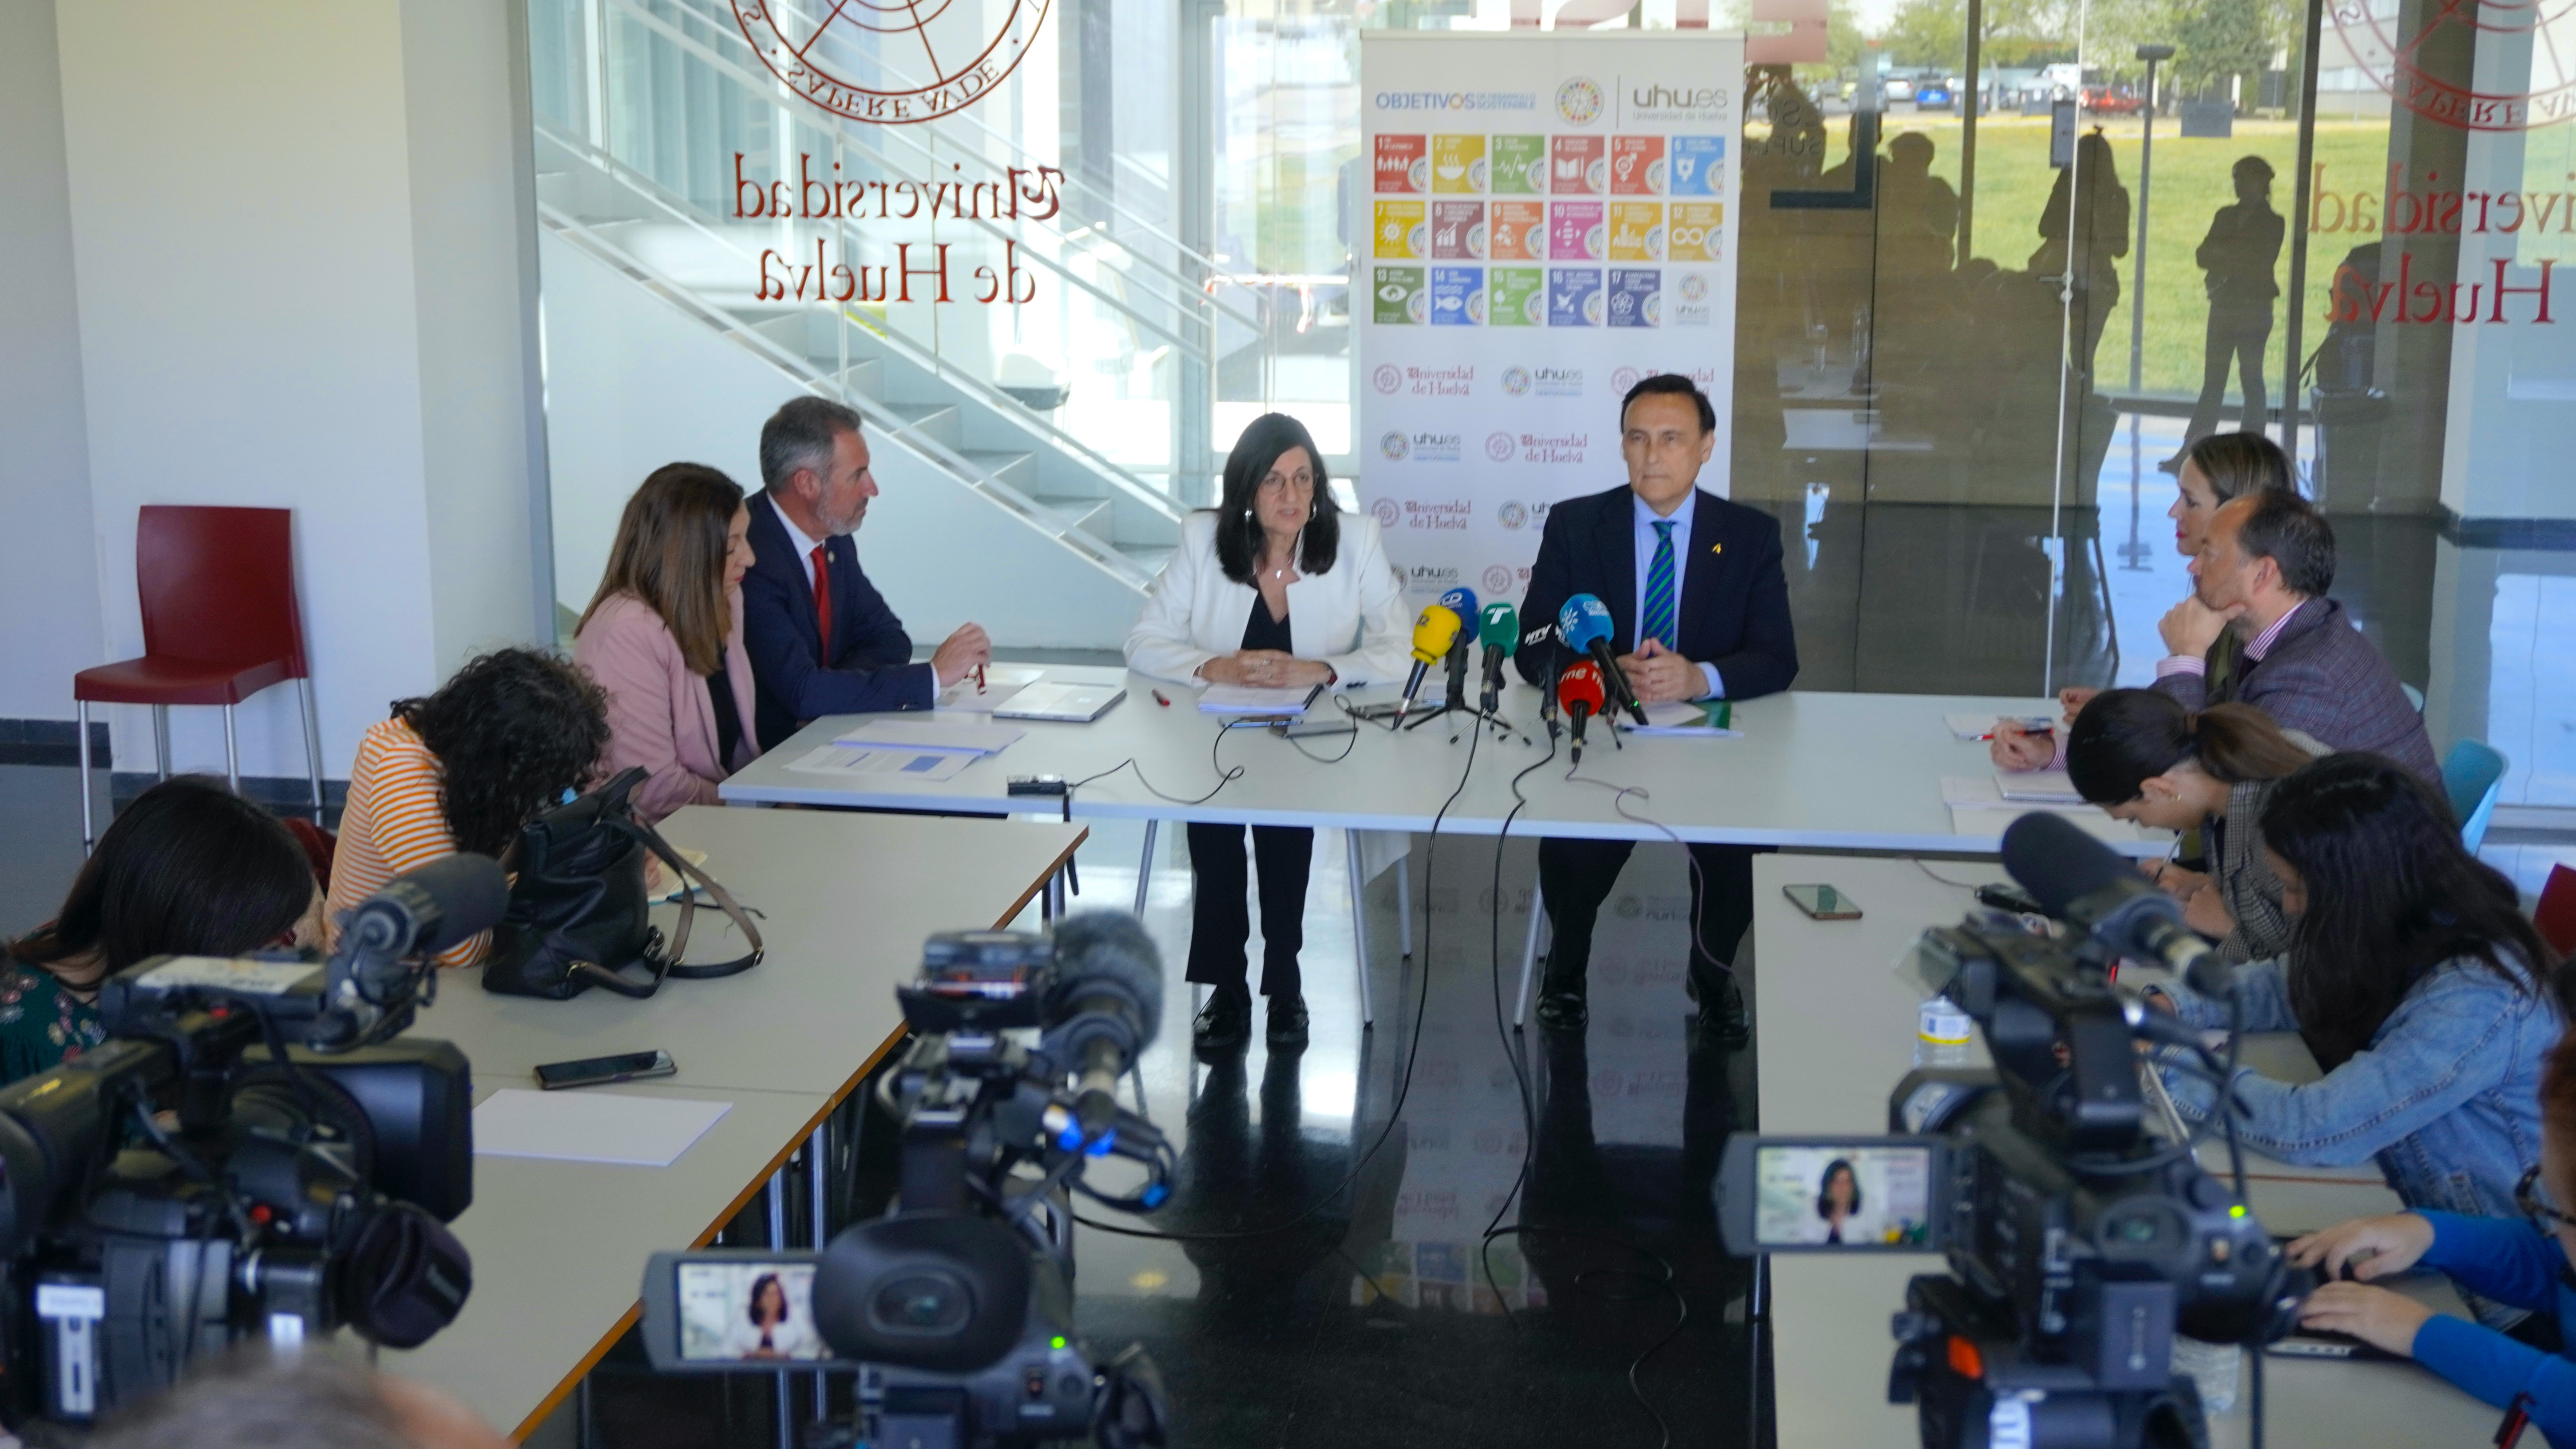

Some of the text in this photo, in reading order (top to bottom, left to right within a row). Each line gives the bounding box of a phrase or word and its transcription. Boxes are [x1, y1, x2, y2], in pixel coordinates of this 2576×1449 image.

[1375, 91, 1477, 110] OBJETIVOS
[1634, 83, 1728, 108] uhu.es
[1378, 137, 1383, 150] 1
[1436, 137, 1442, 150] 2
[1555, 138, 1561, 151] 4
[1554, 204, 1565, 218] 10
[1613, 204, 1621, 218] 11
[1673, 205, 1684, 219] 12
[1377, 268, 1387, 282] 13
[1435, 269, 1445, 282] 14
[1612, 270, 1621, 285] 17
[1407, 364, 1473, 380] Universidad
[1412, 380, 1470, 396] de Huelva
[1521, 432, 1587, 448] Universidad
[1525, 448, 1583, 463] de Huelva
[1405, 499, 1471, 515] Universidad
[1410, 515, 1467, 529] de Huelva
[1561, 668, 1587, 683] rne
